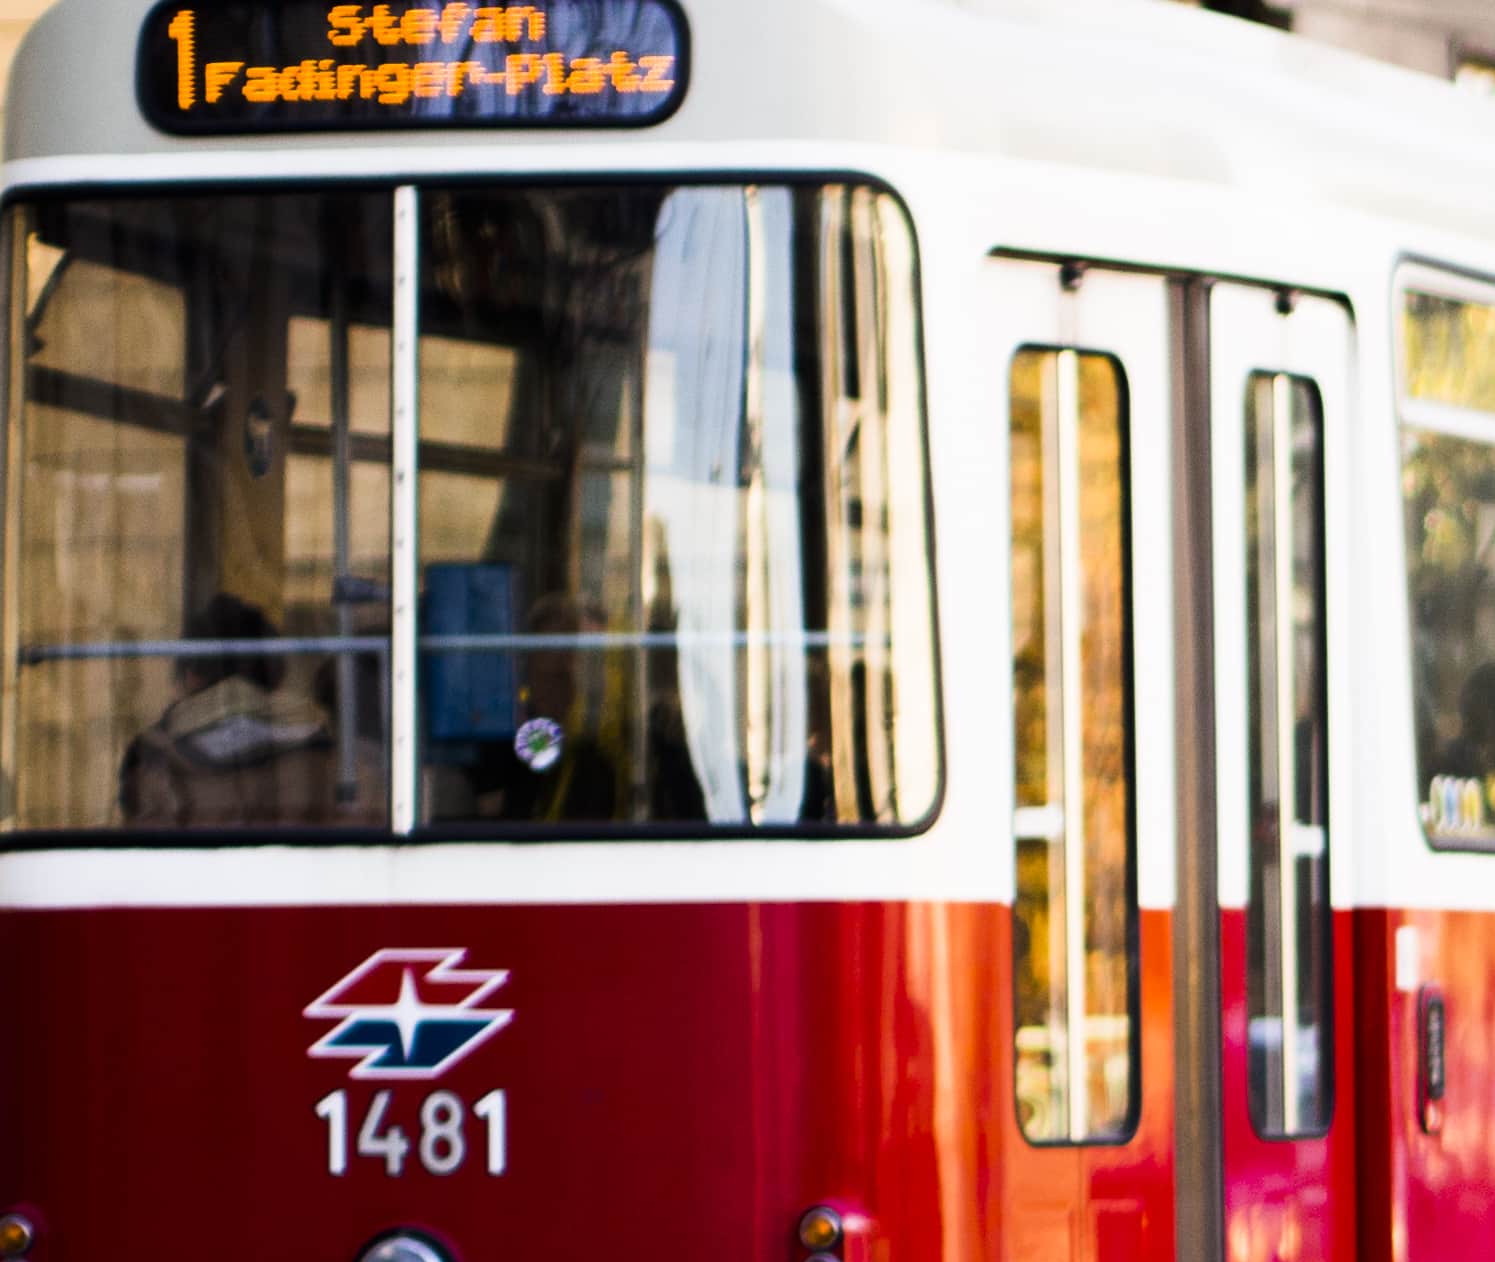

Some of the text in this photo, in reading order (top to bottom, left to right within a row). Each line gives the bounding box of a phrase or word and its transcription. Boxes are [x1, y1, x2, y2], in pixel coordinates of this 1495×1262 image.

[328, 2, 546, 46] Stefan
[168, 10, 196, 110] 1
[205, 51, 675, 105] Fadinger-Platz
[315, 1087, 507, 1176] 1481
